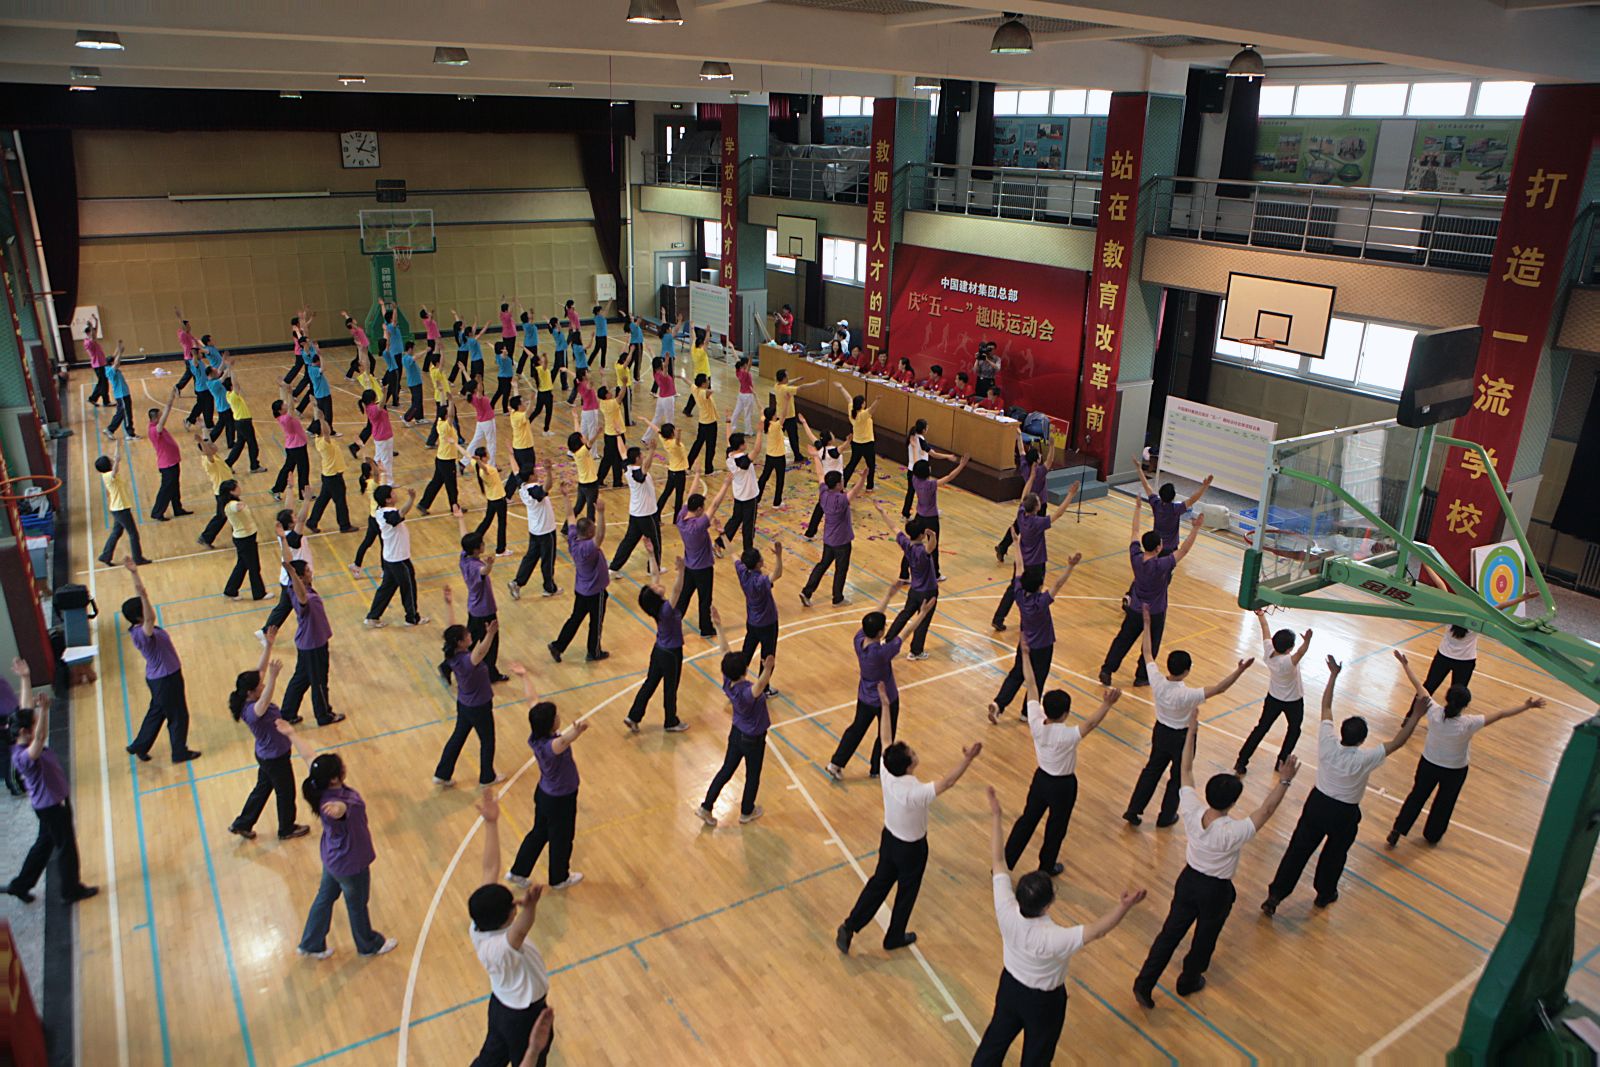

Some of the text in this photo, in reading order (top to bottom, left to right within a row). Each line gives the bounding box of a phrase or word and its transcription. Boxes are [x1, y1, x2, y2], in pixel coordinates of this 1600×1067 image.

[867, 139, 890, 365] 教师是人才的园丁
[941, 276, 1019, 303] 中国建材集团总部
[1086, 150, 1133, 432] 站在教育改革前
[1446, 168, 1568, 539] 打造一流学校
